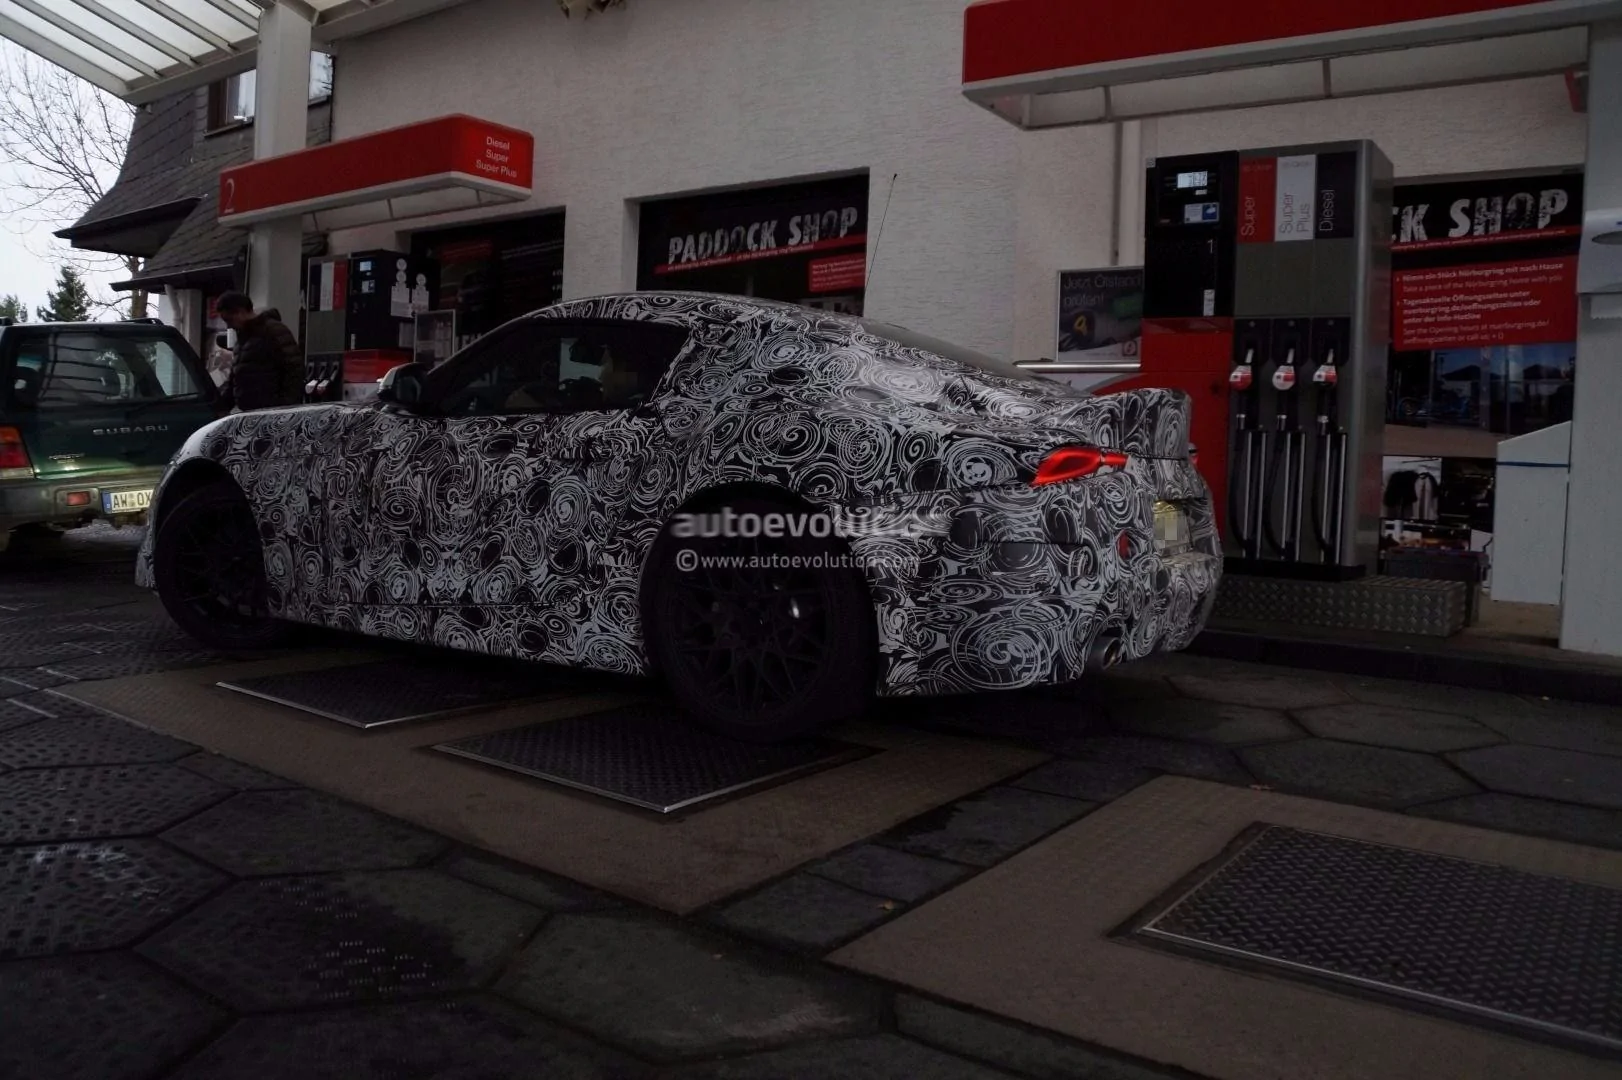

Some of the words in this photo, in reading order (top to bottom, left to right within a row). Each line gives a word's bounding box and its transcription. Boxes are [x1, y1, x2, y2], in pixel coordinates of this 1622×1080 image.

[486, 136, 510, 150] Diesel
[486, 148, 509, 163] Super
[475, 159, 499, 173] Super
[501, 165, 517, 178] Plus
[224, 178, 235, 213] 2
[1319, 189, 1335, 231] Diesel
[1241, 196, 1256, 236] Super
[1279, 192, 1294, 234] Super
[1296, 203, 1310, 233] Plus
[1448, 188, 1569, 238] SHOP
[667, 219, 778, 265] PADDOCK
[787, 206, 859, 246] SHOP
[92, 425, 168, 436] SUBARU
[113, 494, 128, 508] AW
